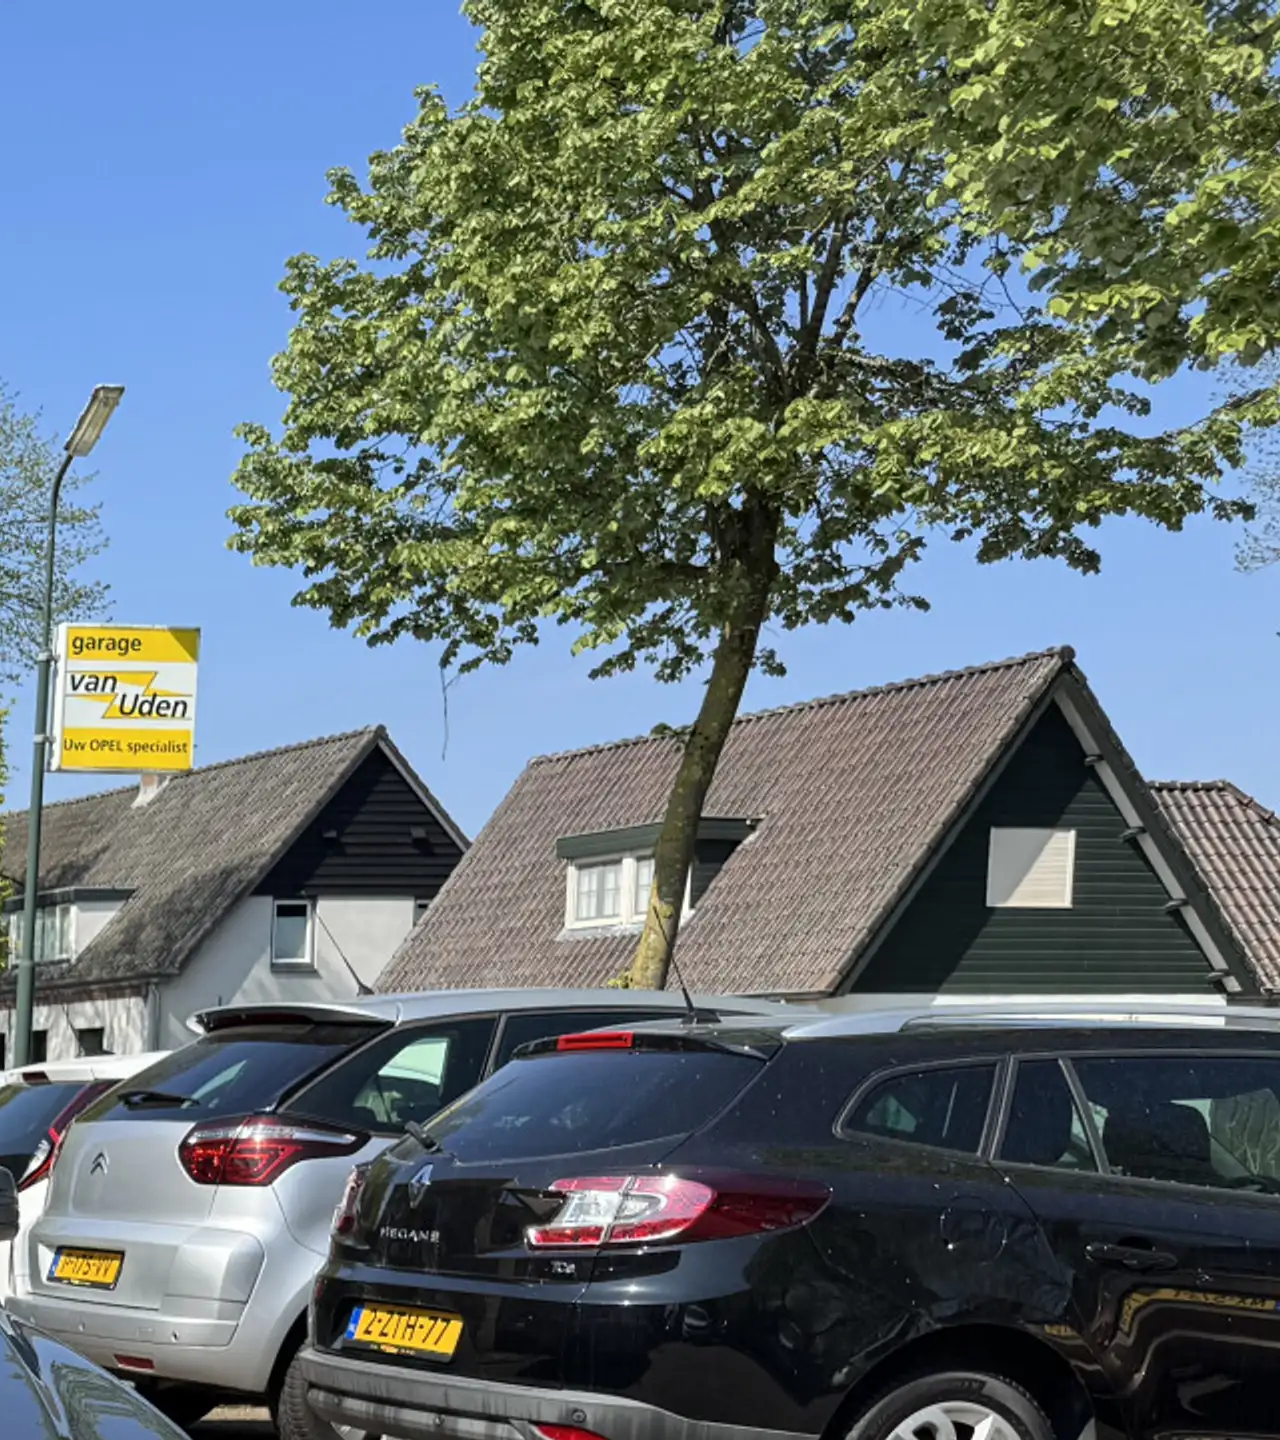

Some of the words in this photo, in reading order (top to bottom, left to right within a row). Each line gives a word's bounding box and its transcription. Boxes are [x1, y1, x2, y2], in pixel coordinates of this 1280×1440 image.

[71, 634, 143, 656] garage
[70, 673, 118, 693] van
[118, 692, 189, 719] Uden
[63, 738, 87, 752] Uw
[89, 738, 124, 753] OPEL
[126, 739, 188, 755] specialist
[362, 1308, 452, 1346] 2-ZTH-77
